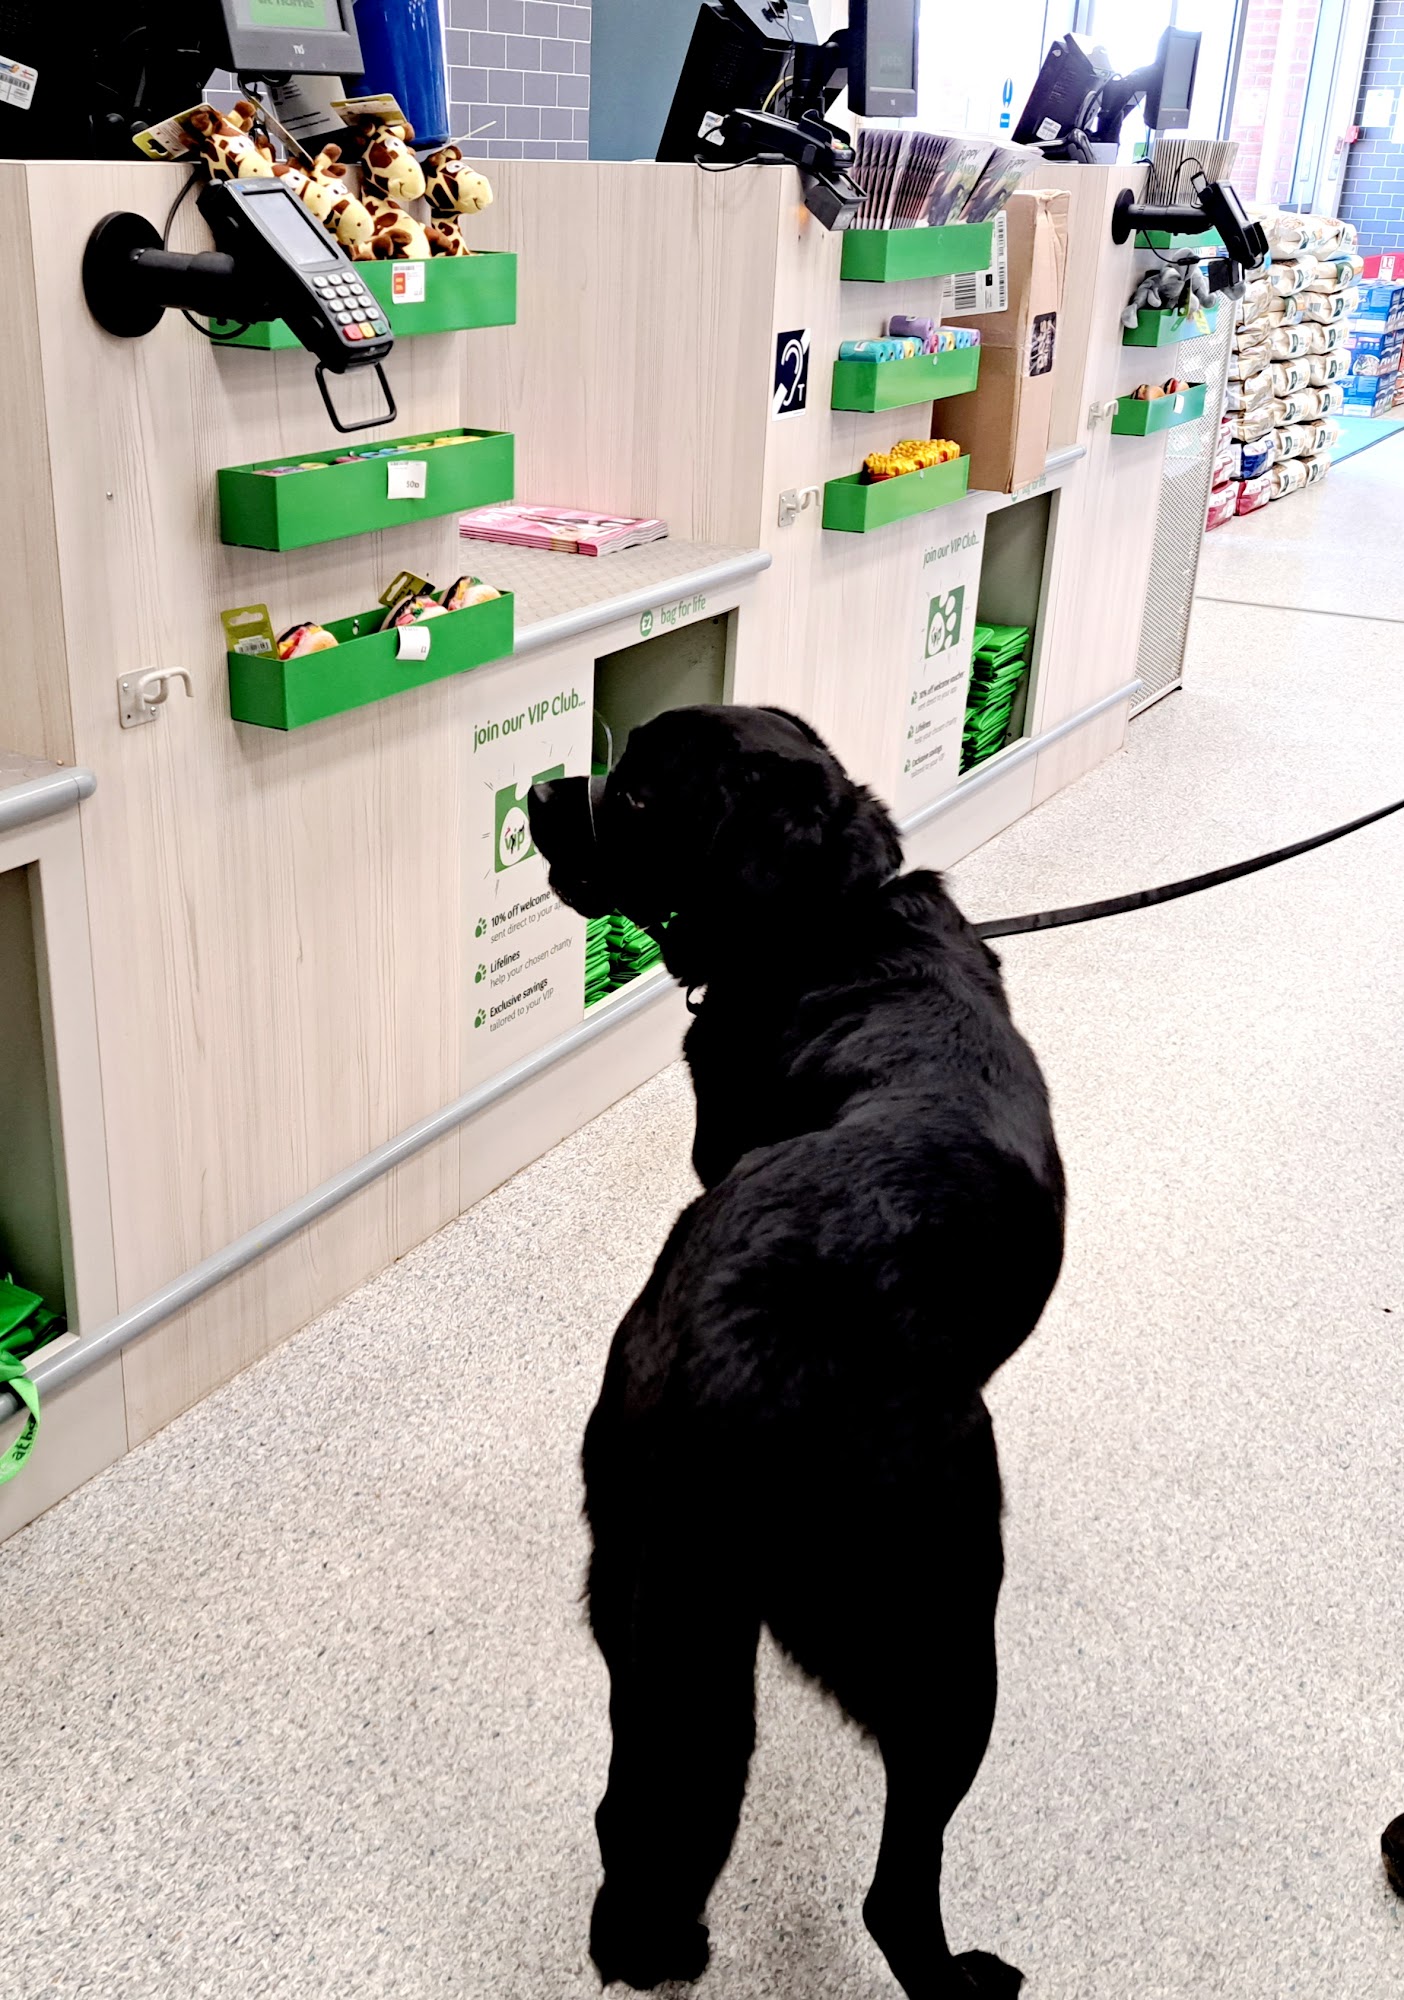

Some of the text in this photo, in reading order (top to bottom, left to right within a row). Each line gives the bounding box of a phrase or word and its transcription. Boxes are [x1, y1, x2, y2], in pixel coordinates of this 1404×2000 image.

[797, 383, 805, 402] T
[950, 536, 962, 554] VIP
[660, 594, 706, 625] bag for life
[473, 720, 499, 754] join
[502, 713, 525, 736] our
[528, 700, 549, 725] VIP
[504, 827, 525, 852] vip
[490, 929, 507, 944] sent
[507, 919, 527, 935] direct
[528, 913, 536, 924] to
[537, 904, 553, 923] your
[491, 911, 506, 928] 10%
[507, 902, 521, 920] off
[520, 890, 551, 913] welcome
[490, 950, 520, 974] Lifelines
[490, 936, 573, 989] help your chosen charity
[489, 987, 555, 1033] tailored to your VIP
[490, 978, 548, 1018] Exclusive savings
